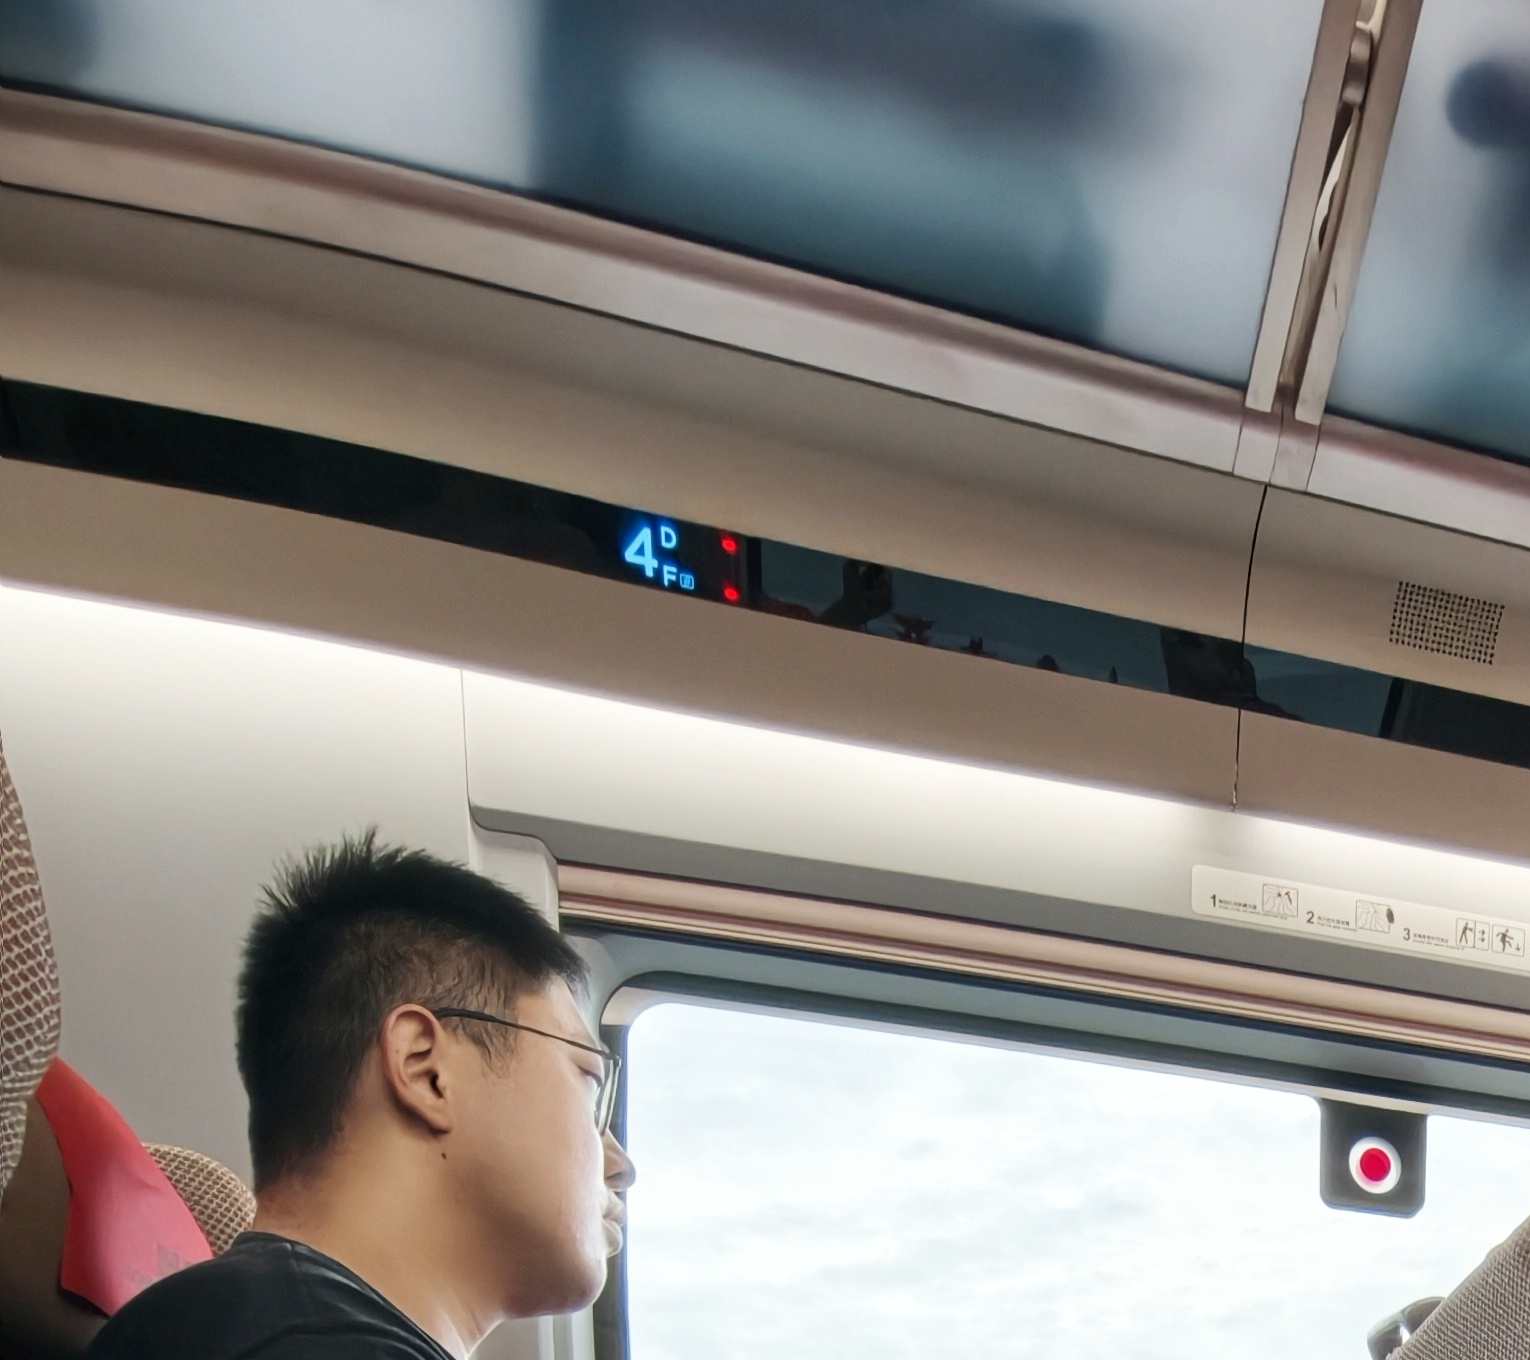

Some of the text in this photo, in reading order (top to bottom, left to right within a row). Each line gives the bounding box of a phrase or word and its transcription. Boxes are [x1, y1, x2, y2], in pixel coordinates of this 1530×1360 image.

[624, 525, 677, 577] 4 D
[662, 565, 678, 587] F
[1210, 893, 1217, 908] 1
[1306, 910, 1315, 925] 2
[1402, 927, 1411, 941] 3
